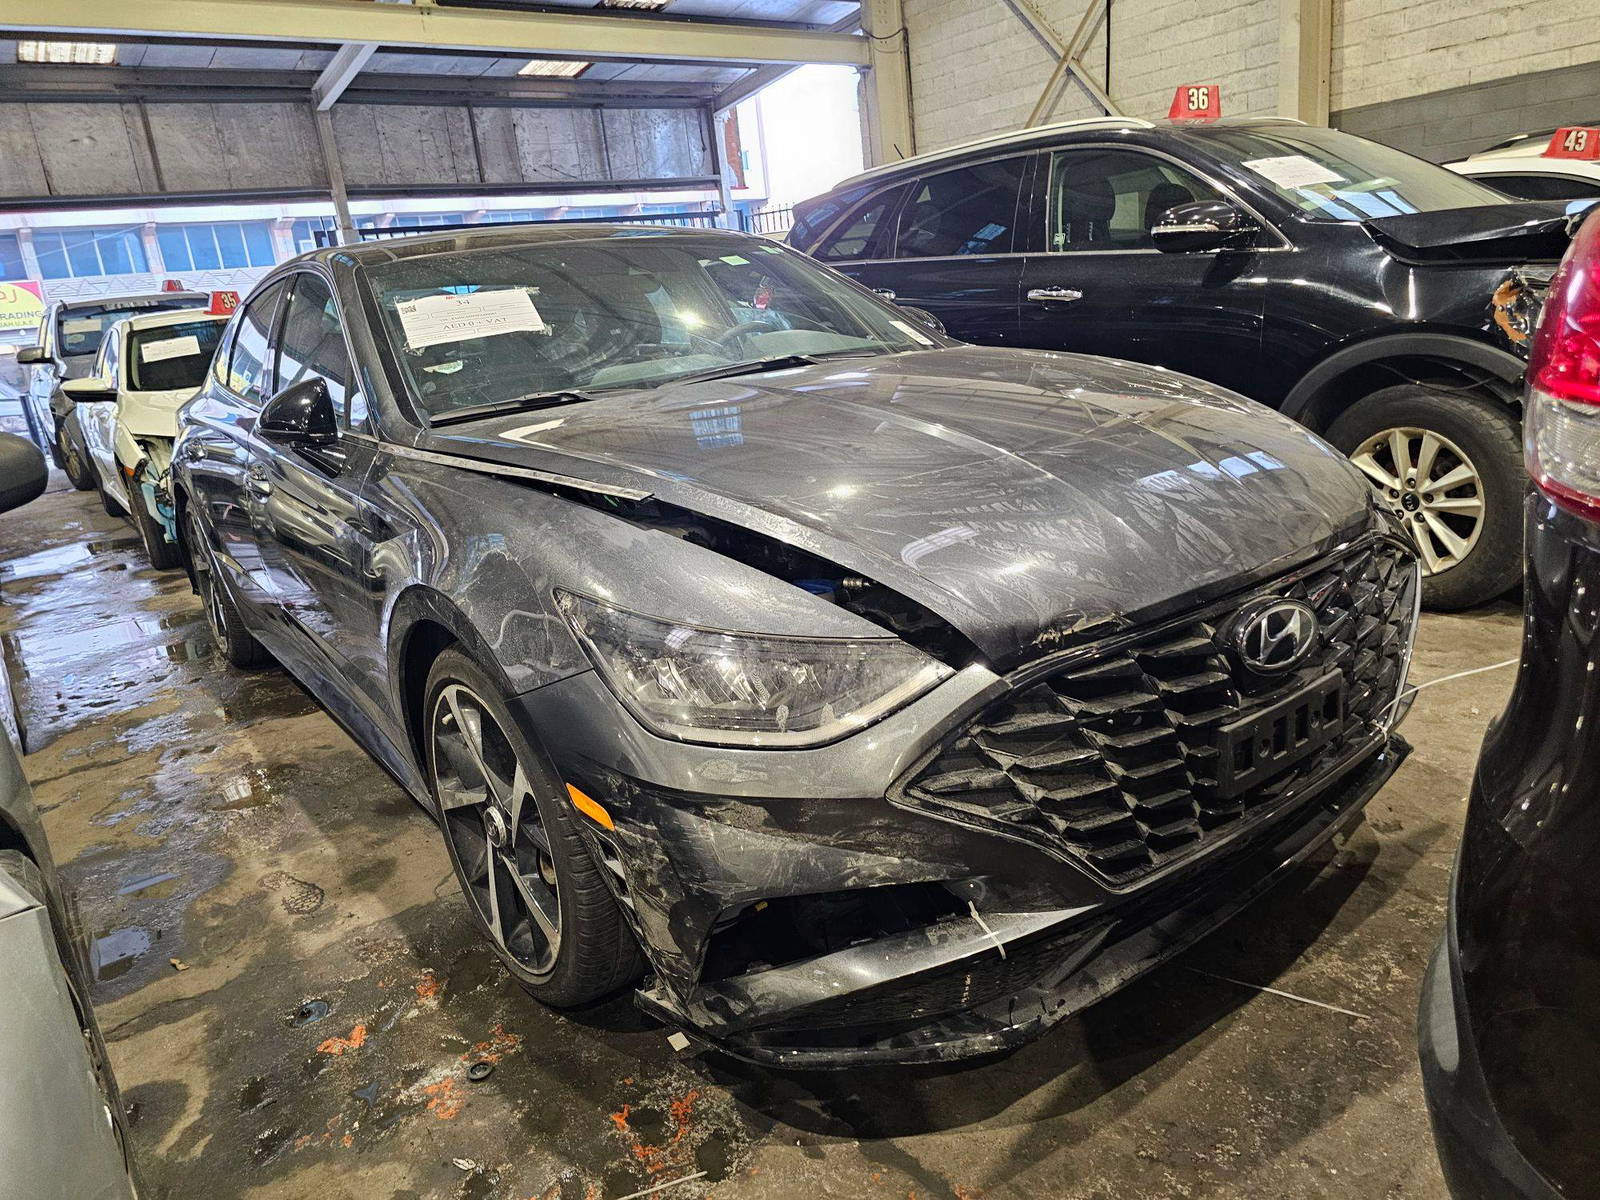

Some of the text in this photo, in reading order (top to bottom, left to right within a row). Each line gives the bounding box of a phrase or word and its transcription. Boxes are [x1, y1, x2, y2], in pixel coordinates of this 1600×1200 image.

[1188, 87, 1209, 110] 36
[1563, 129, 1589, 152] 43
[221, 292, 237, 309] 35
